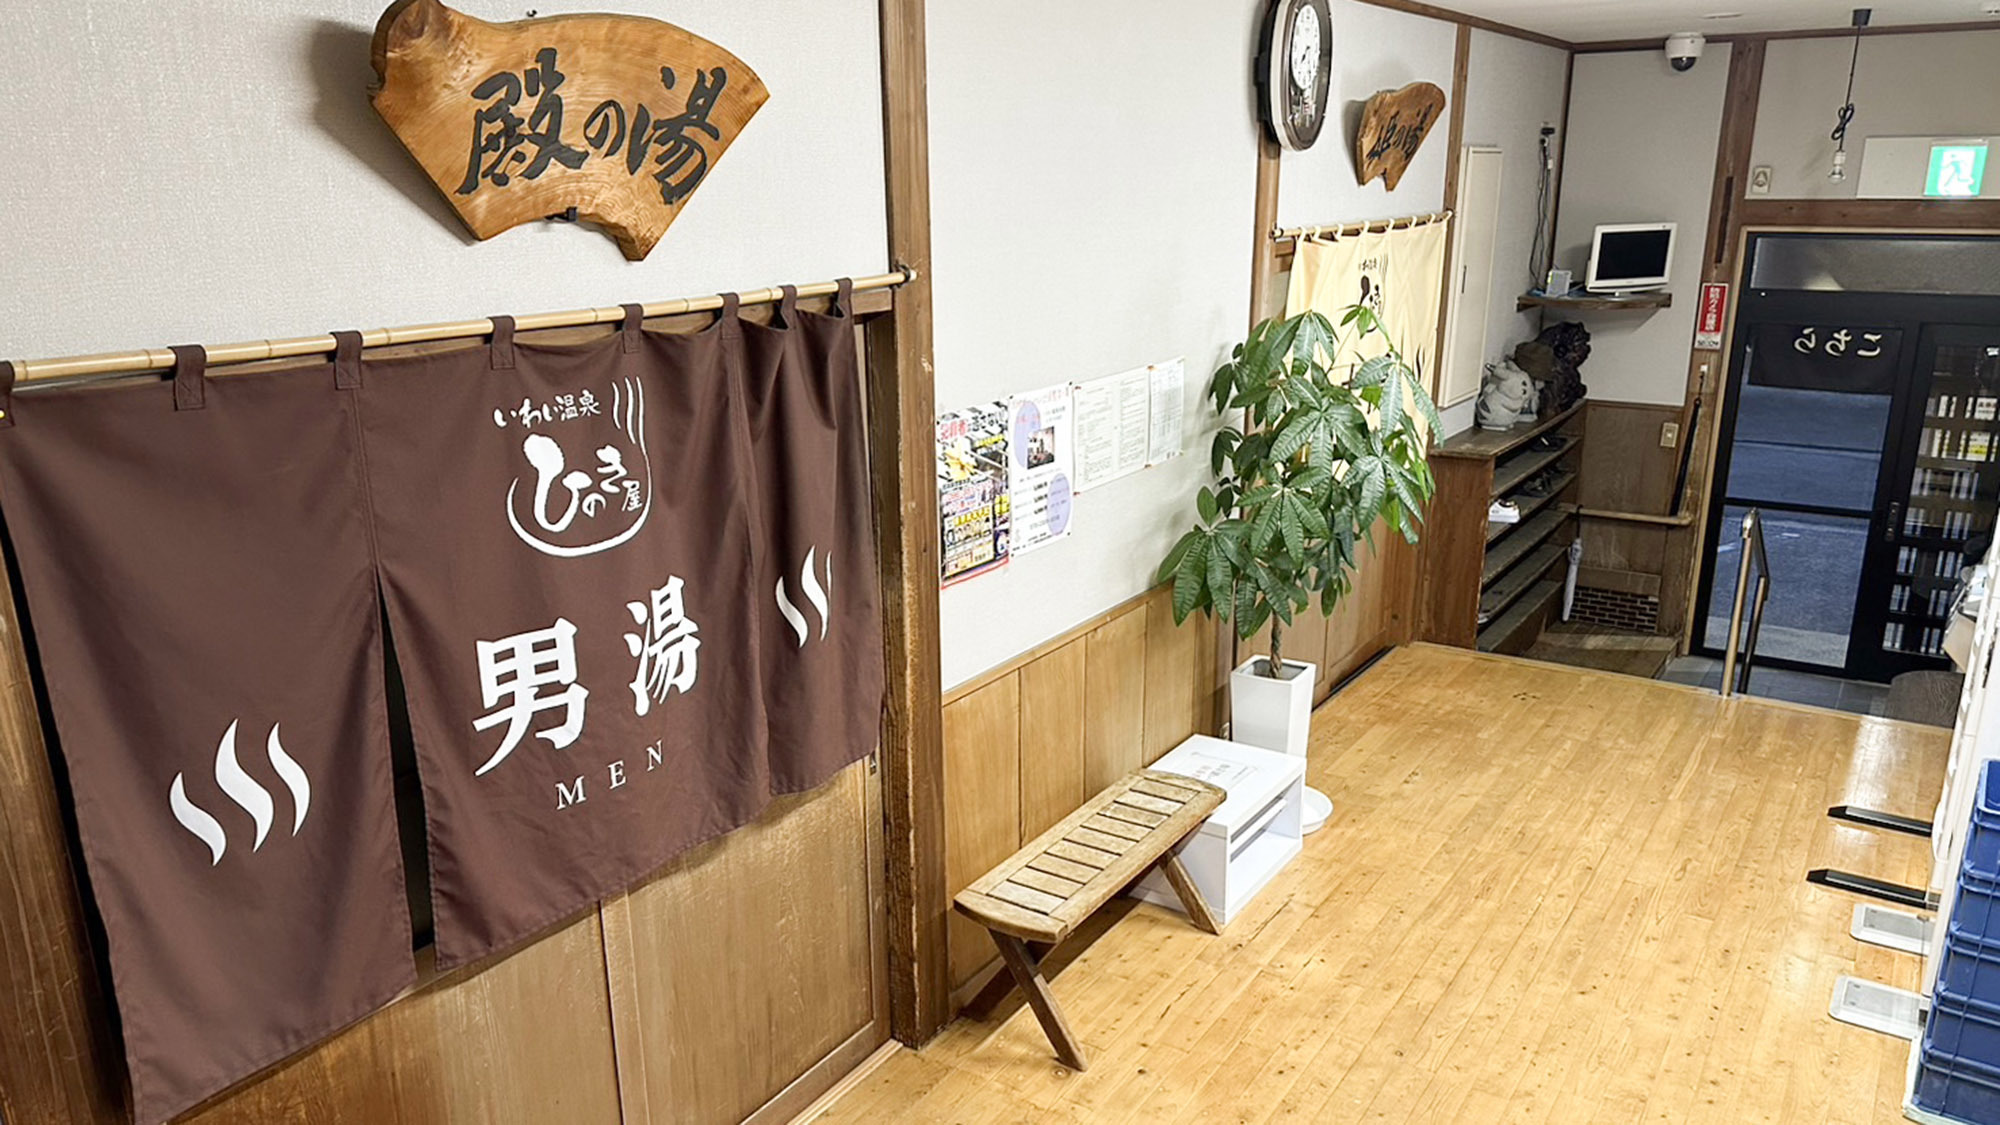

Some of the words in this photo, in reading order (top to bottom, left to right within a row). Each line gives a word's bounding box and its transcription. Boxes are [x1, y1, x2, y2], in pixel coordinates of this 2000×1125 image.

[455, 47, 727, 205] 殿の湯
[493, 388, 601, 429] いわい温泉
[522, 432, 644, 534] ひのき屋
[472, 574, 702, 778] 男湯
[555, 740, 666, 811] MEN
